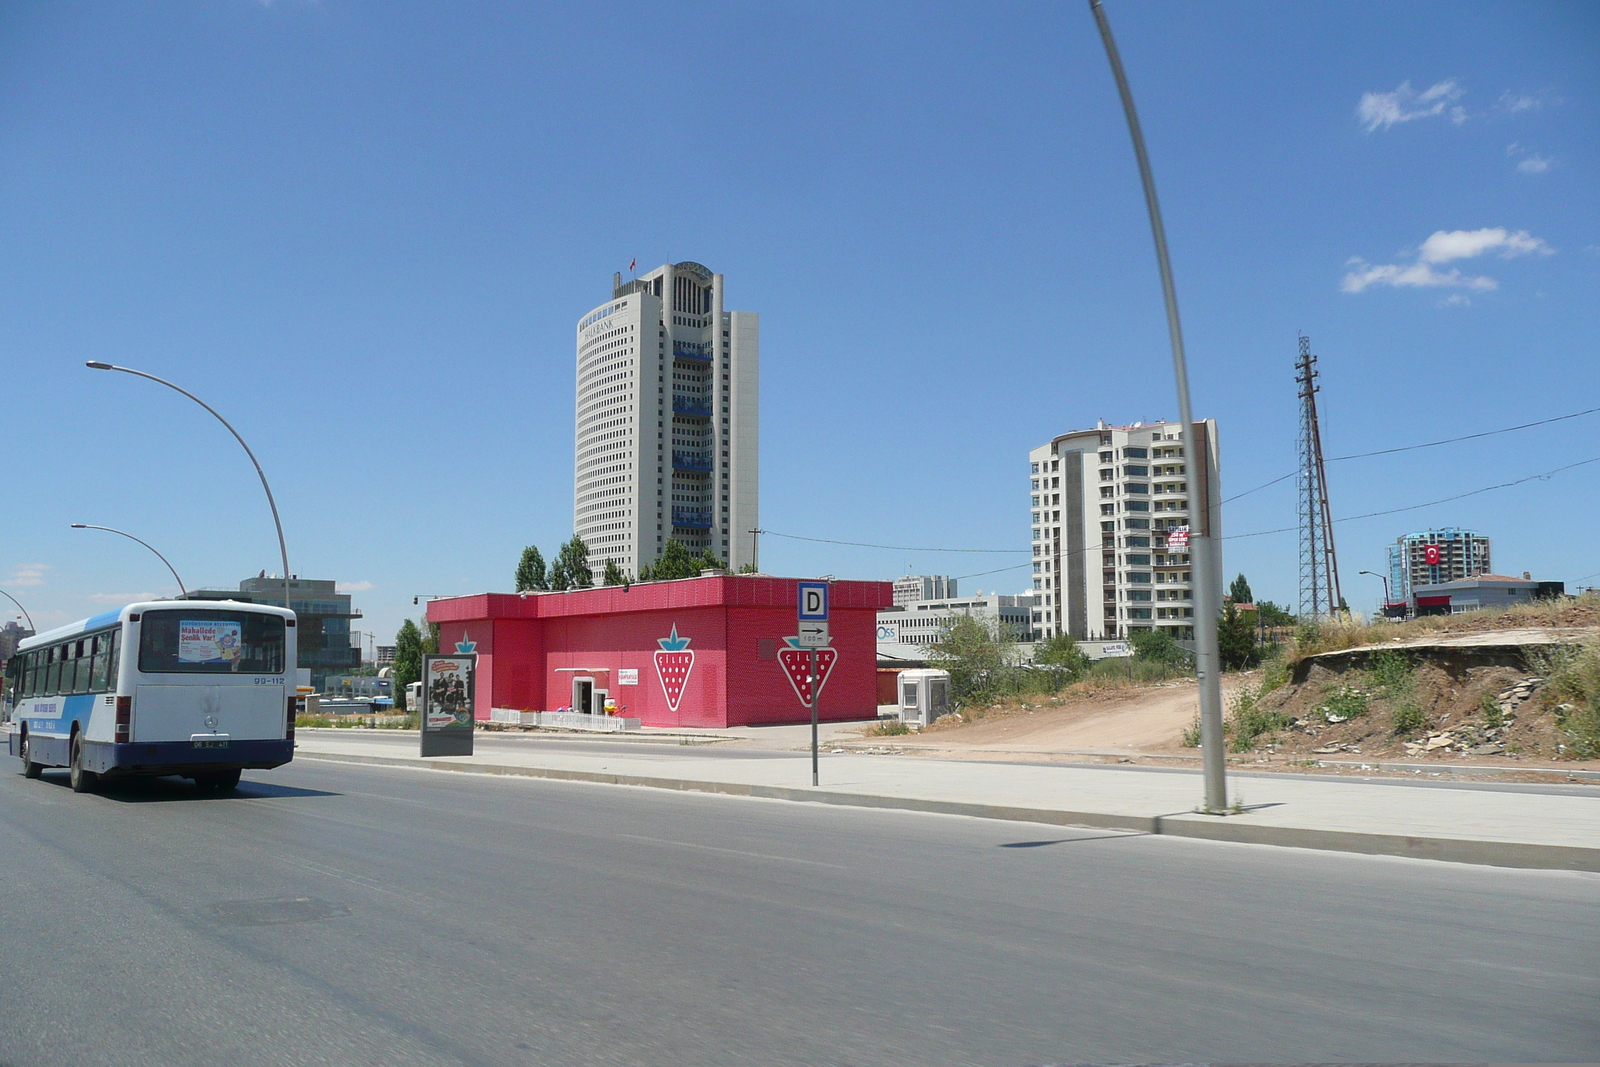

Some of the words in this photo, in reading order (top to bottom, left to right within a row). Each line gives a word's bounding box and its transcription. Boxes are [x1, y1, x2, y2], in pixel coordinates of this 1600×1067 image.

[585, 319, 614, 341] HALKBANK
[807, 591, 820, 612] D
[181, 626, 217, 634] Mahallede
[181, 634, 201, 642] Şenlik
[658, 654, 690, 666] ÇİLEK
[785, 652, 830, 664] ÇİLEK
[254, 677, 285, 685] 99-112
